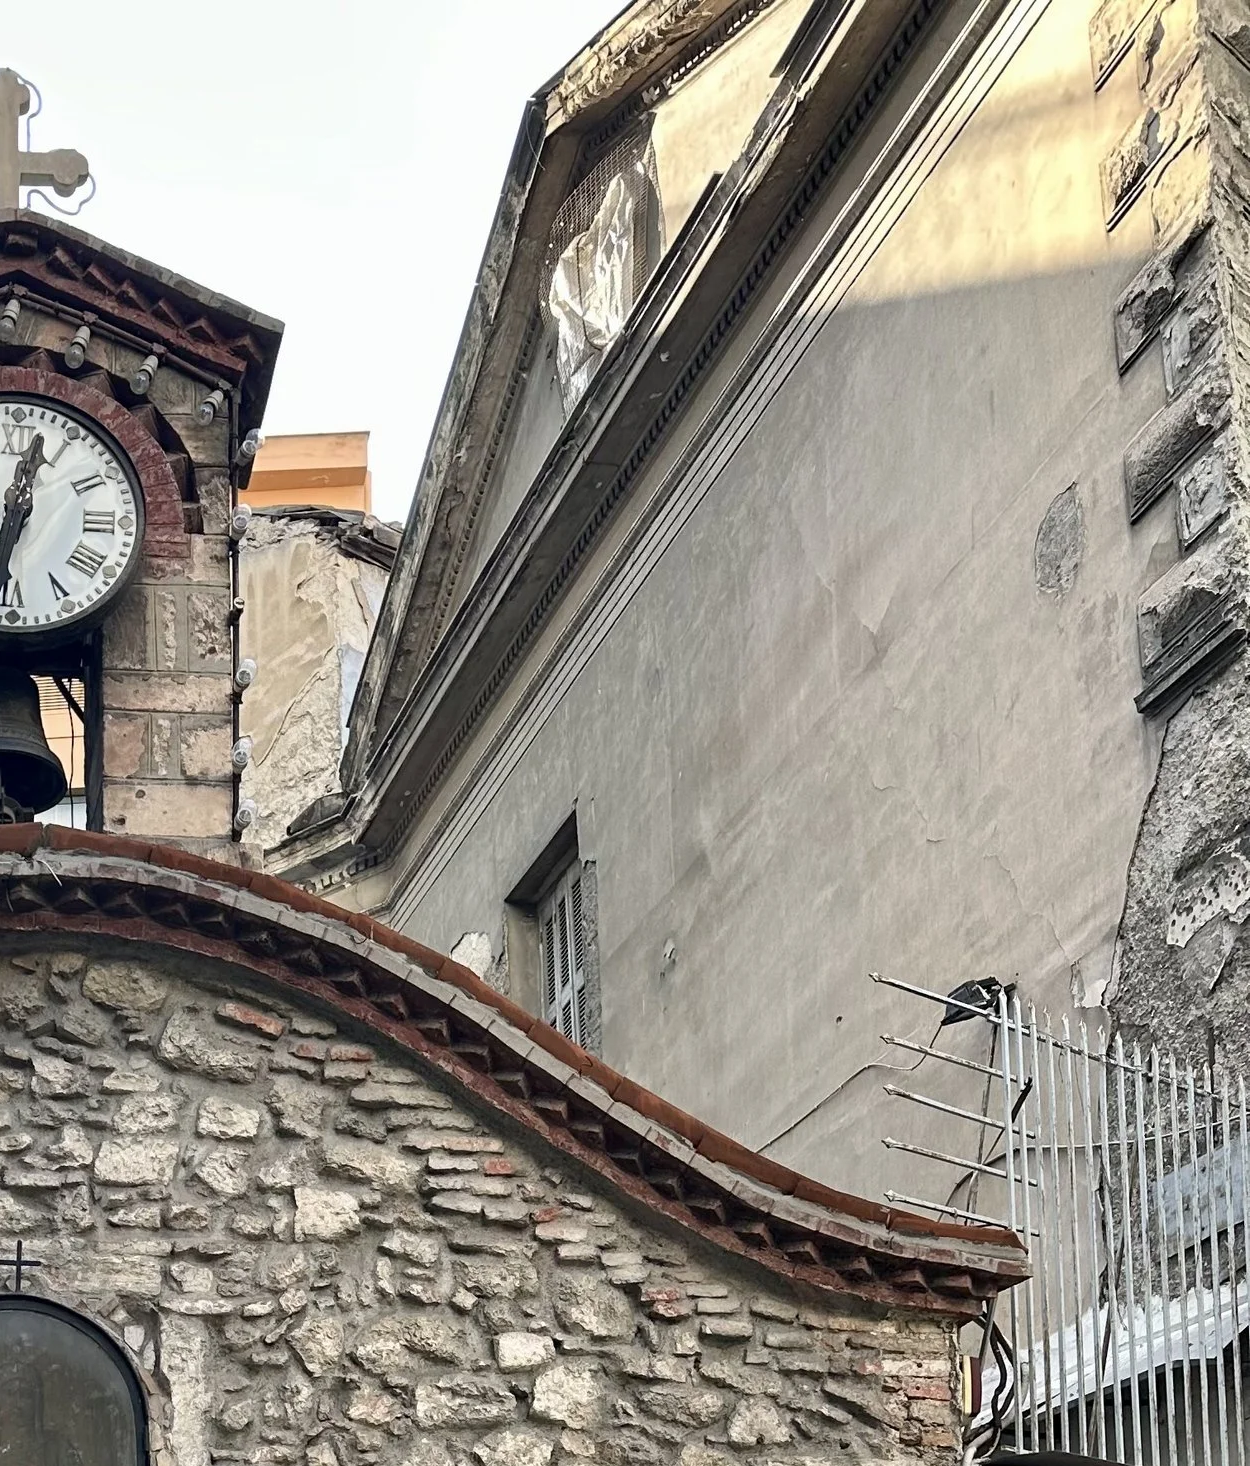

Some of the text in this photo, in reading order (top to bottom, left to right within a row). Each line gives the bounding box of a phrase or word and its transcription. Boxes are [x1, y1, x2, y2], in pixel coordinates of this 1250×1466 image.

[49, 439, 70, 467] I
[71, 470, 107, 496] II
[83, 509, 115, 535] III
[66, 540, 107, 578] IIII
[0, 577, 24, 608] VI
[48, 571, 70, 600] V
